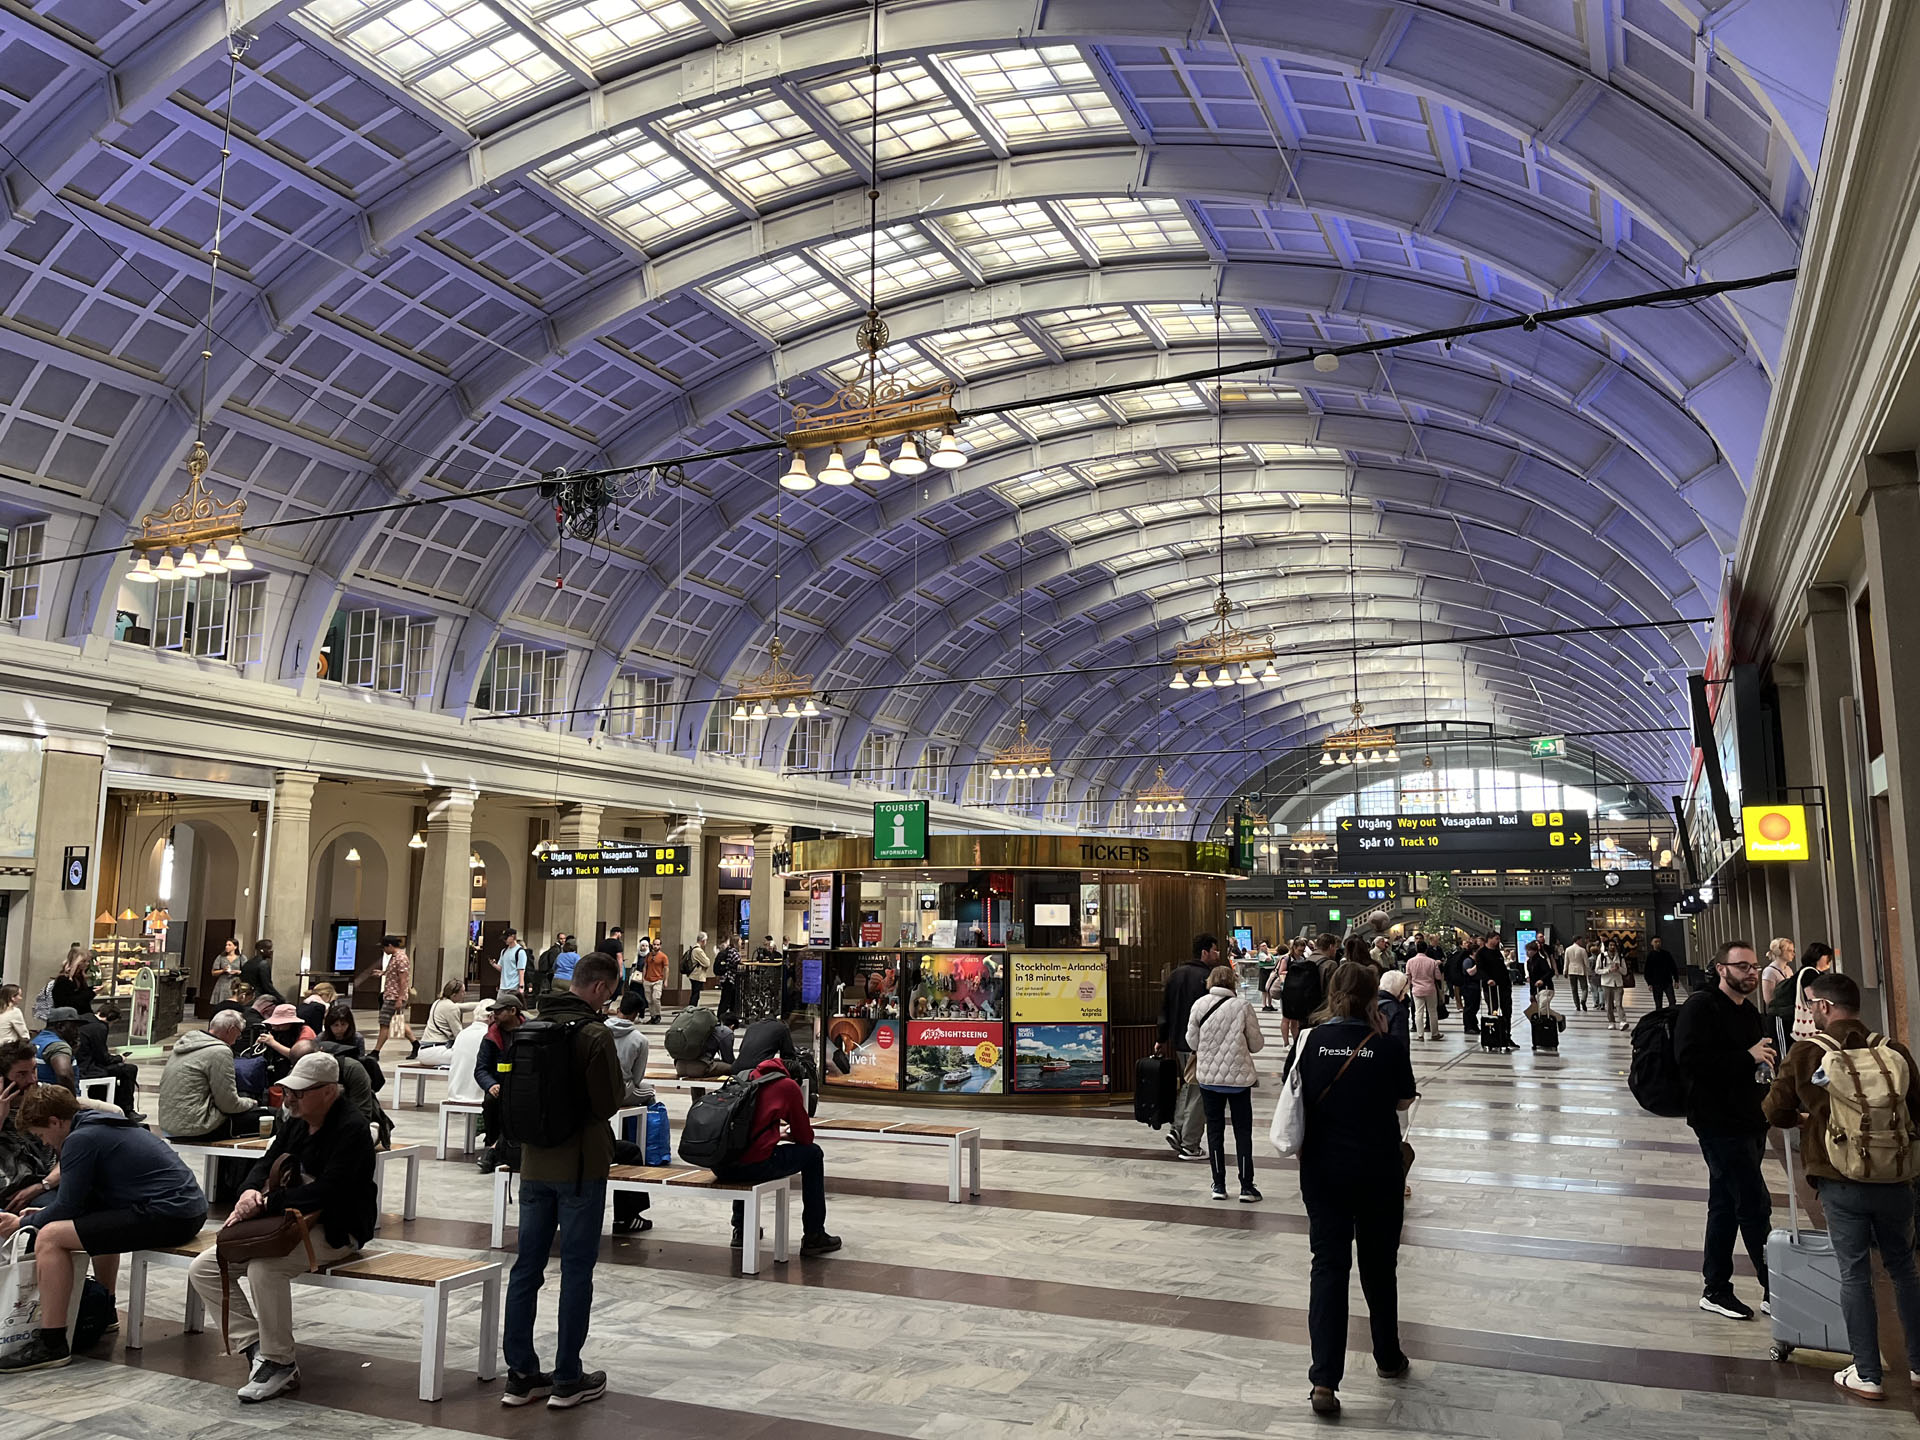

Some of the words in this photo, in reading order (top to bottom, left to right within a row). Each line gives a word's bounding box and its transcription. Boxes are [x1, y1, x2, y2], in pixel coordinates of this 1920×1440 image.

[880, 804, 919, 812] TOURIST
[1358, 819, 1392, 830] Utgång
[1397, 819, 1417, 830] Way
[1420, 818, 1436, 827] out
[1441, 816, 1492, 827] Vasagatan
[1498, 816, 1518, 825] Taxi
[1359, 838, 1380, 849] Spår
[1384, 837, 1394, 847] 10
[1400, 837, 1424, 847] Track
[1428, 836, 1438, 846] 10
[551, 852, 572, 861] Utgång
[575, 852, 588, 861] Way
[602, 851, 632, 860] Vasagatan
[1079, 844, 1150, 862] TICKETS
[551, 867, 564, 876] Spår
[1319, 1046, 1374, 1058] Pressbrån
[849, 1051, 867, 1065] live
[868, 1054, 876, 1066] it
